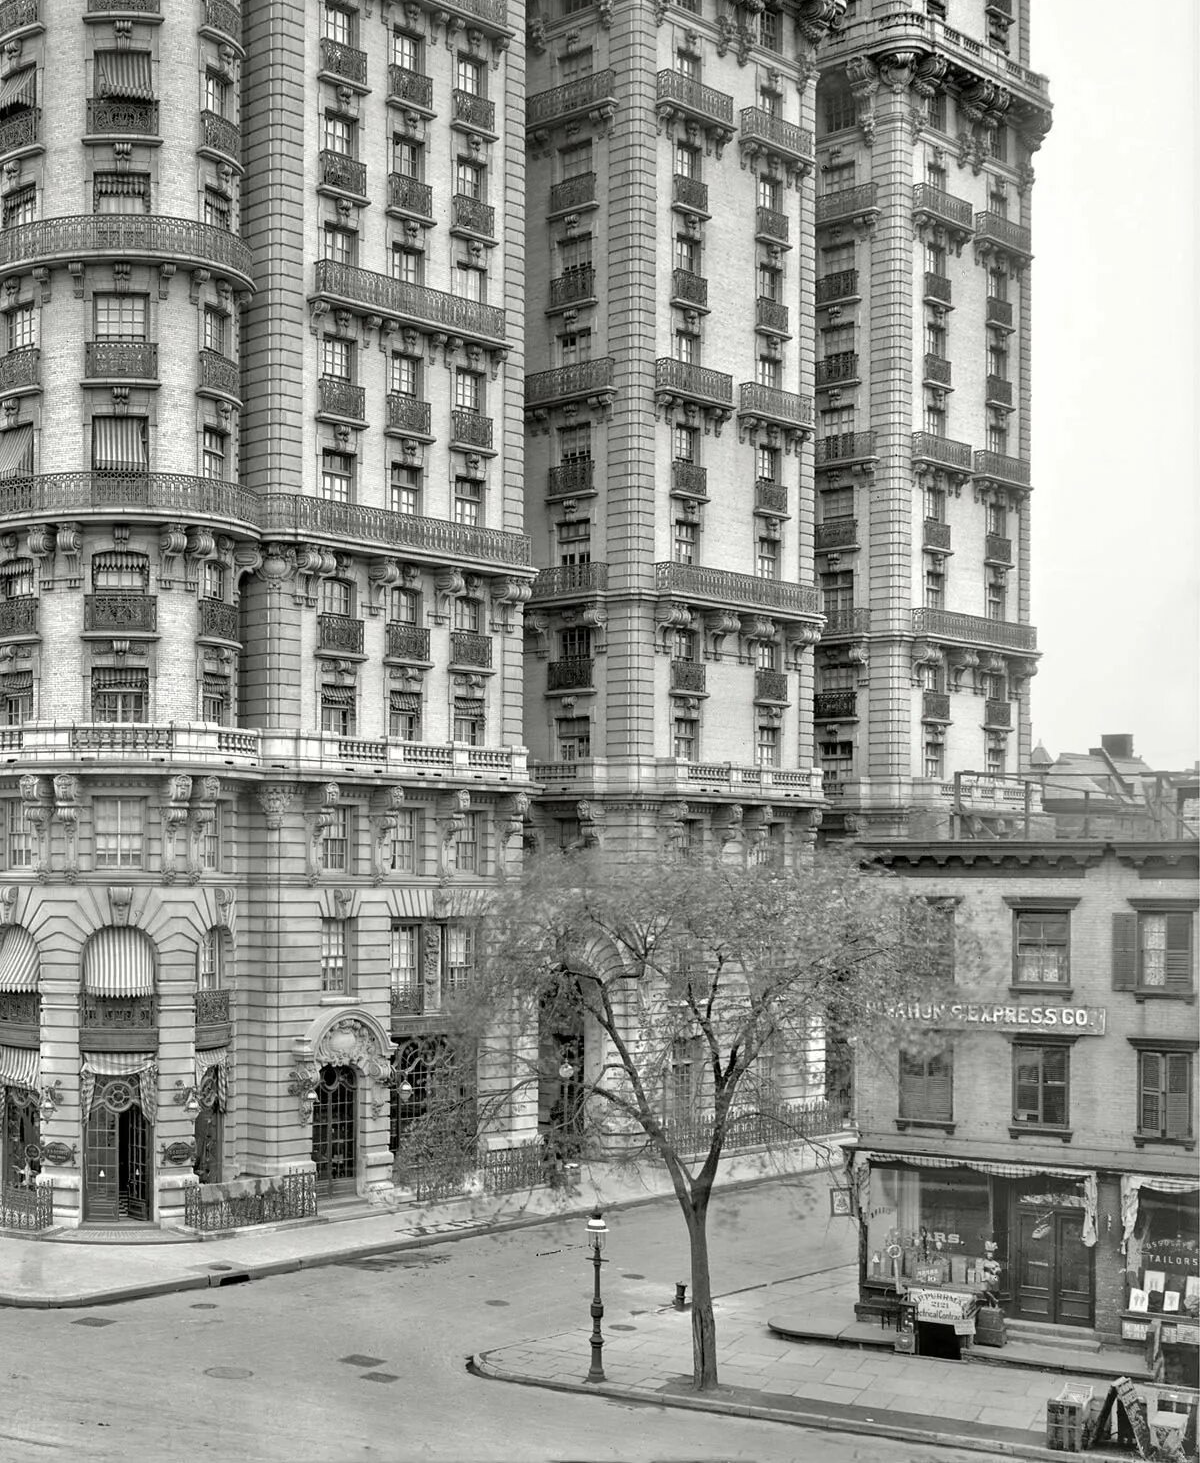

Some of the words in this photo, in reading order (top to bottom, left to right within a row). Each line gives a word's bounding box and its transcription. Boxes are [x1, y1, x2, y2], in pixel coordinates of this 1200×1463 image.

[967, 1004, 1058, 1025] EXPRESS
[1061, 1009, 1094, 1026] CO.
[1149, 1254, 1199, 1266] TAILORS
[939, 1309, 962, 1321] Contrac
